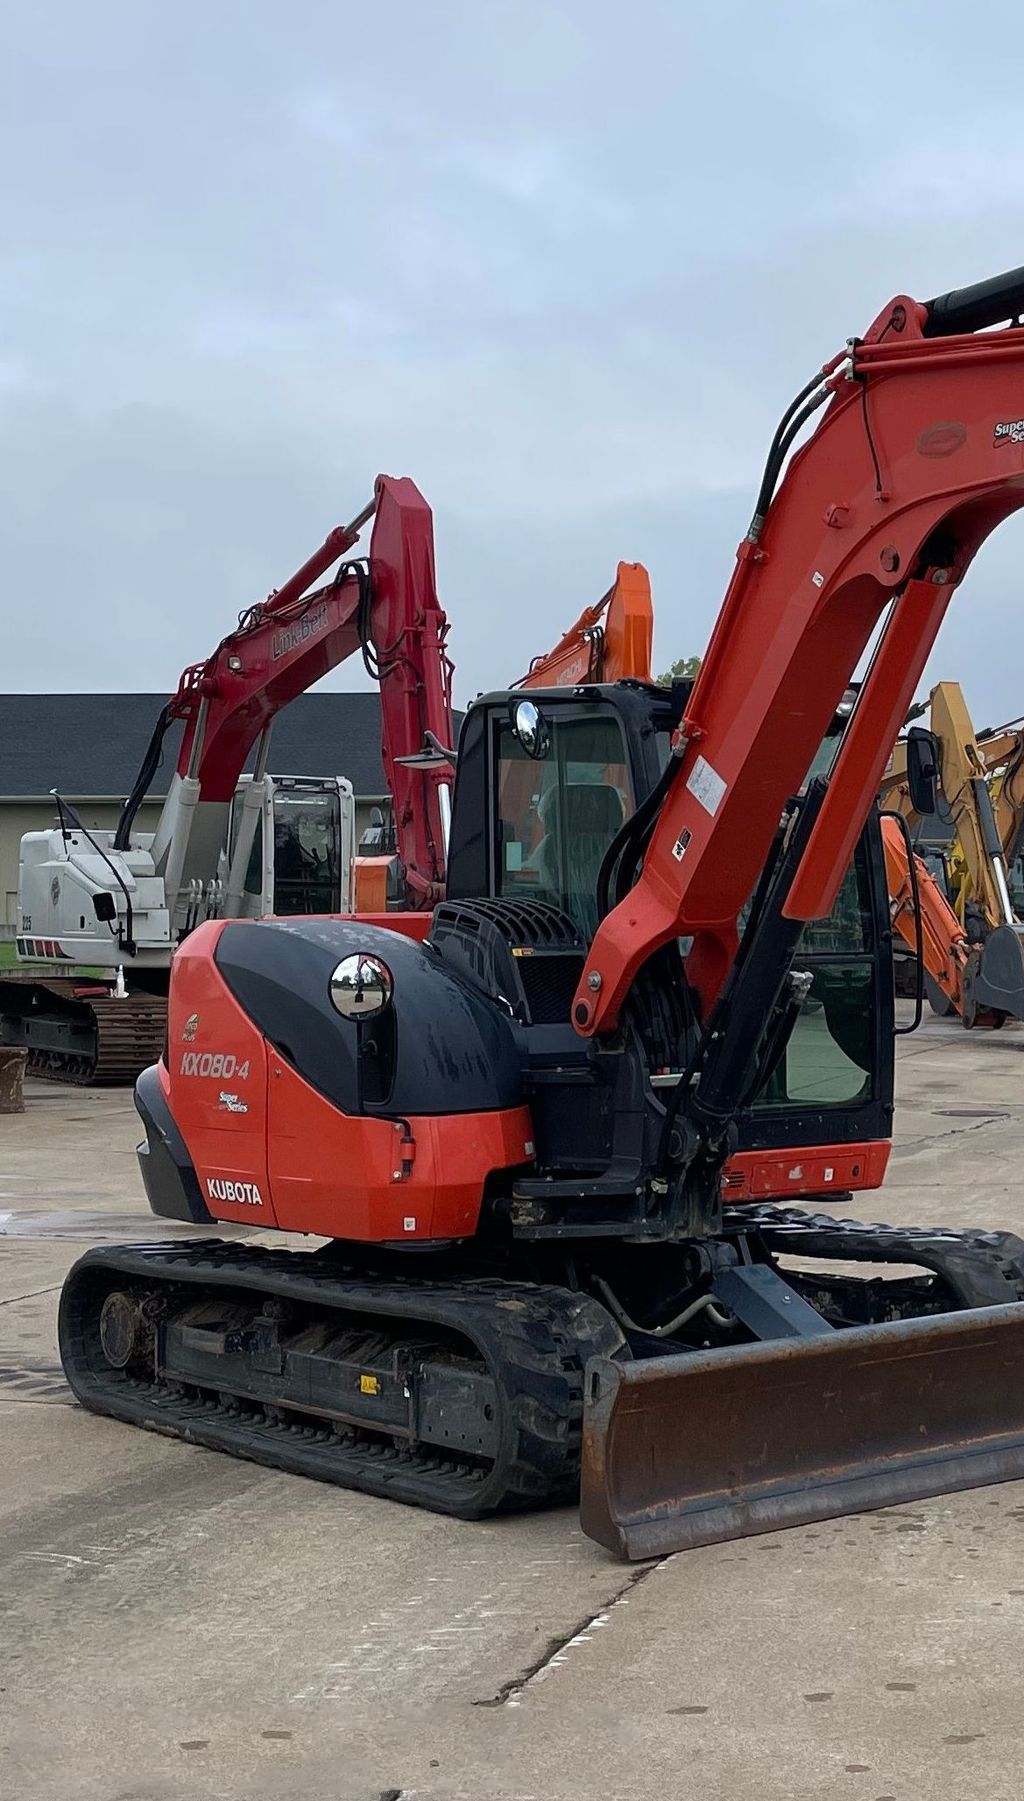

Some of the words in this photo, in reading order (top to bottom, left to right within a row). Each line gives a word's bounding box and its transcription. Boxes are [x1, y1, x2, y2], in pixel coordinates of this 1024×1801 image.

[272, 601, 328, 661] Link-Belt
[180, 1052, 250, 1080] KX080-4
[219, 1091, 239, 1103] Super
[226, 1101, 248, 1113] Series
[206, 1177, 264, 1206] KUBOTA
